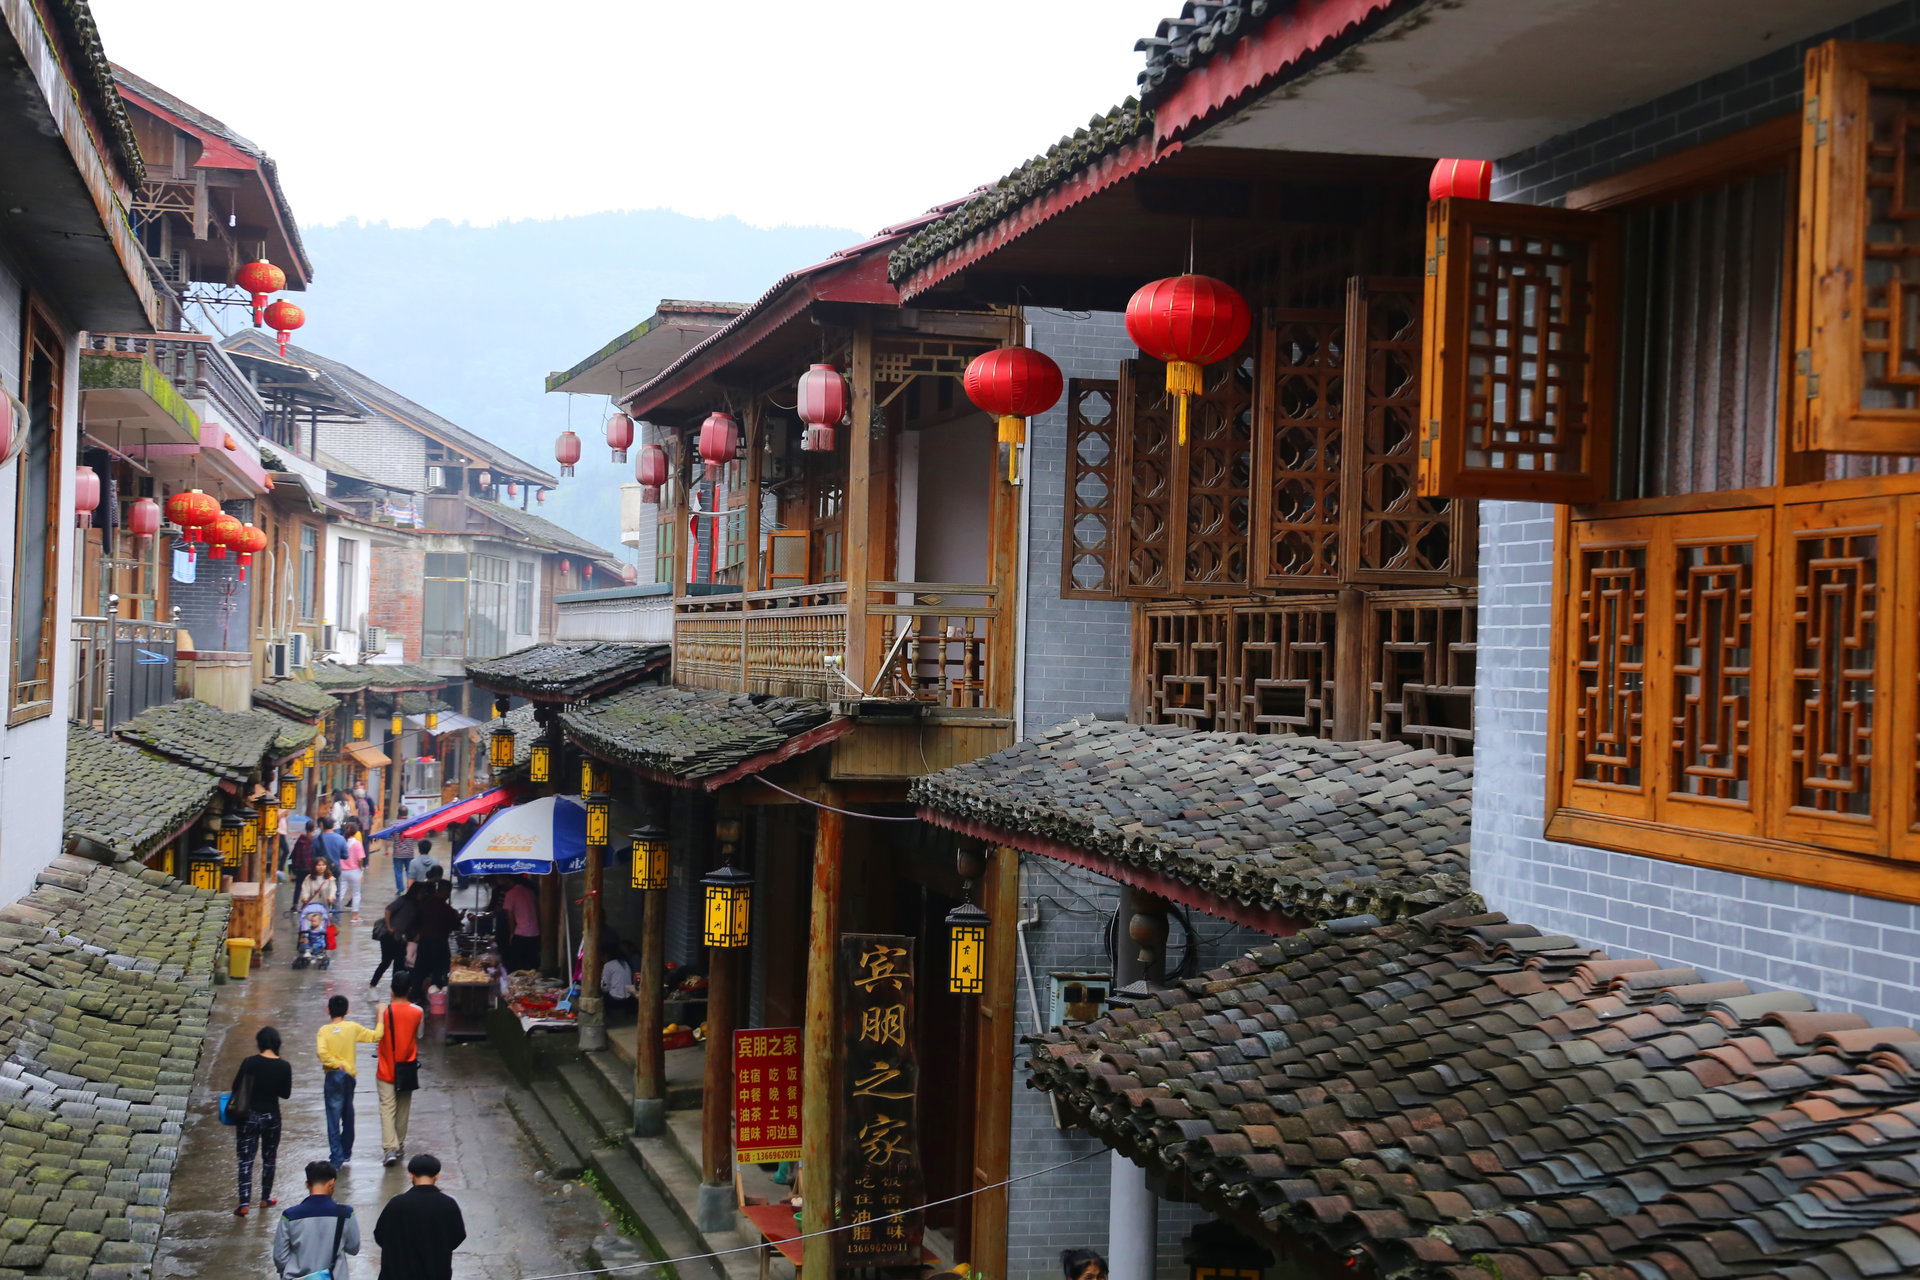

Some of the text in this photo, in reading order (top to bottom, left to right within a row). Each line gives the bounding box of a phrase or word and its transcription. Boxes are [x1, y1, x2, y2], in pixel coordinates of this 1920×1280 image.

[961, 943, 972, 976] 古城
[738, 1033, 798, 1058] 宾朋之家
[852, 944, 916, 1166] 宾朋之家
[739, 1068, 761, 1084] 住宿
[739, 1087, 761, 1103] 中餐
[739, 1107, 762, 1122] 油茶
[740, 1124, 798, 1142] 腊味 河边鱼
